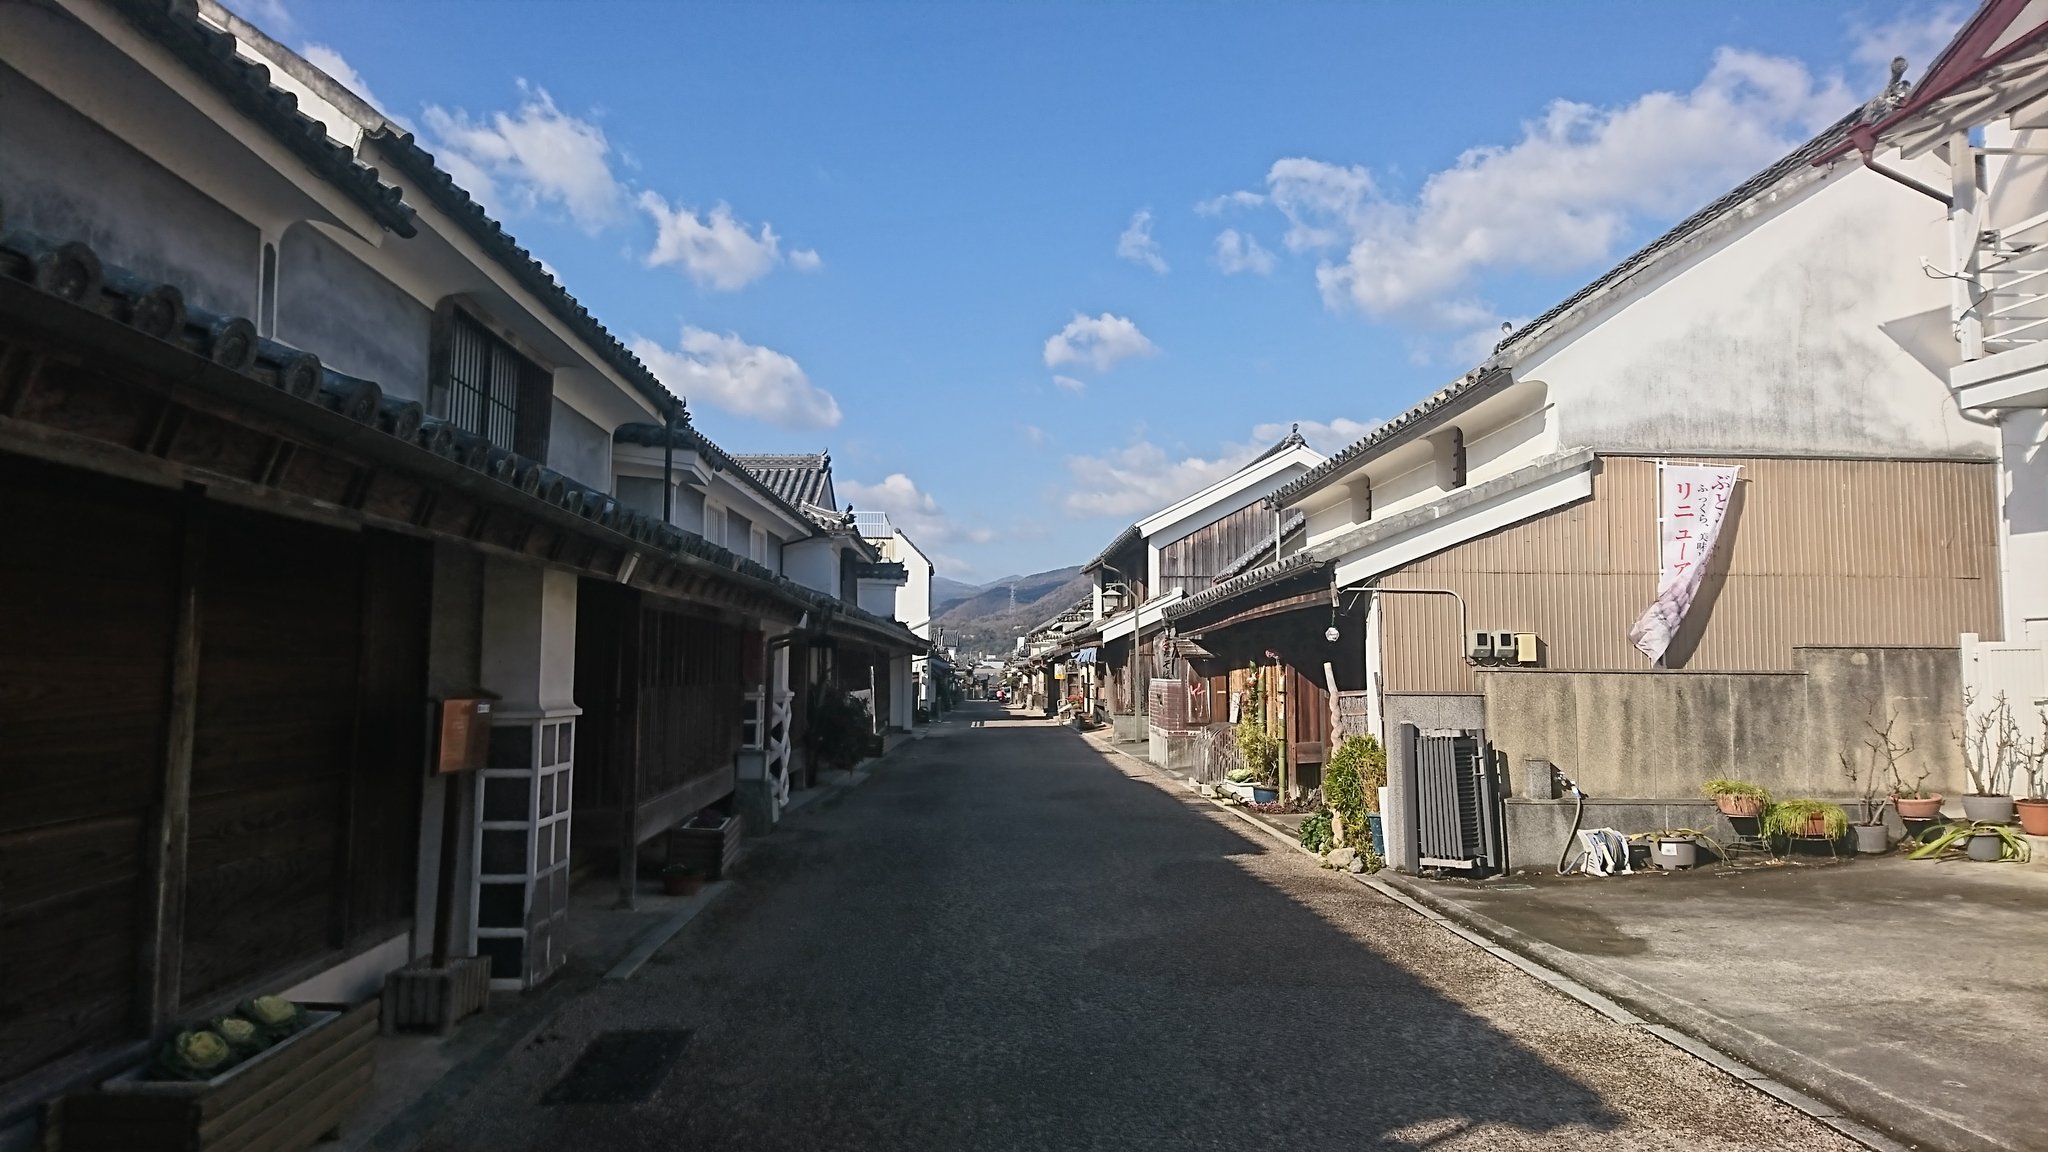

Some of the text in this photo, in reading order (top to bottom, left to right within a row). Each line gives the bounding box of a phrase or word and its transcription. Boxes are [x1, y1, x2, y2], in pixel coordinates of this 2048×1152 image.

[1674, 483, 1694, 576] リニューア
